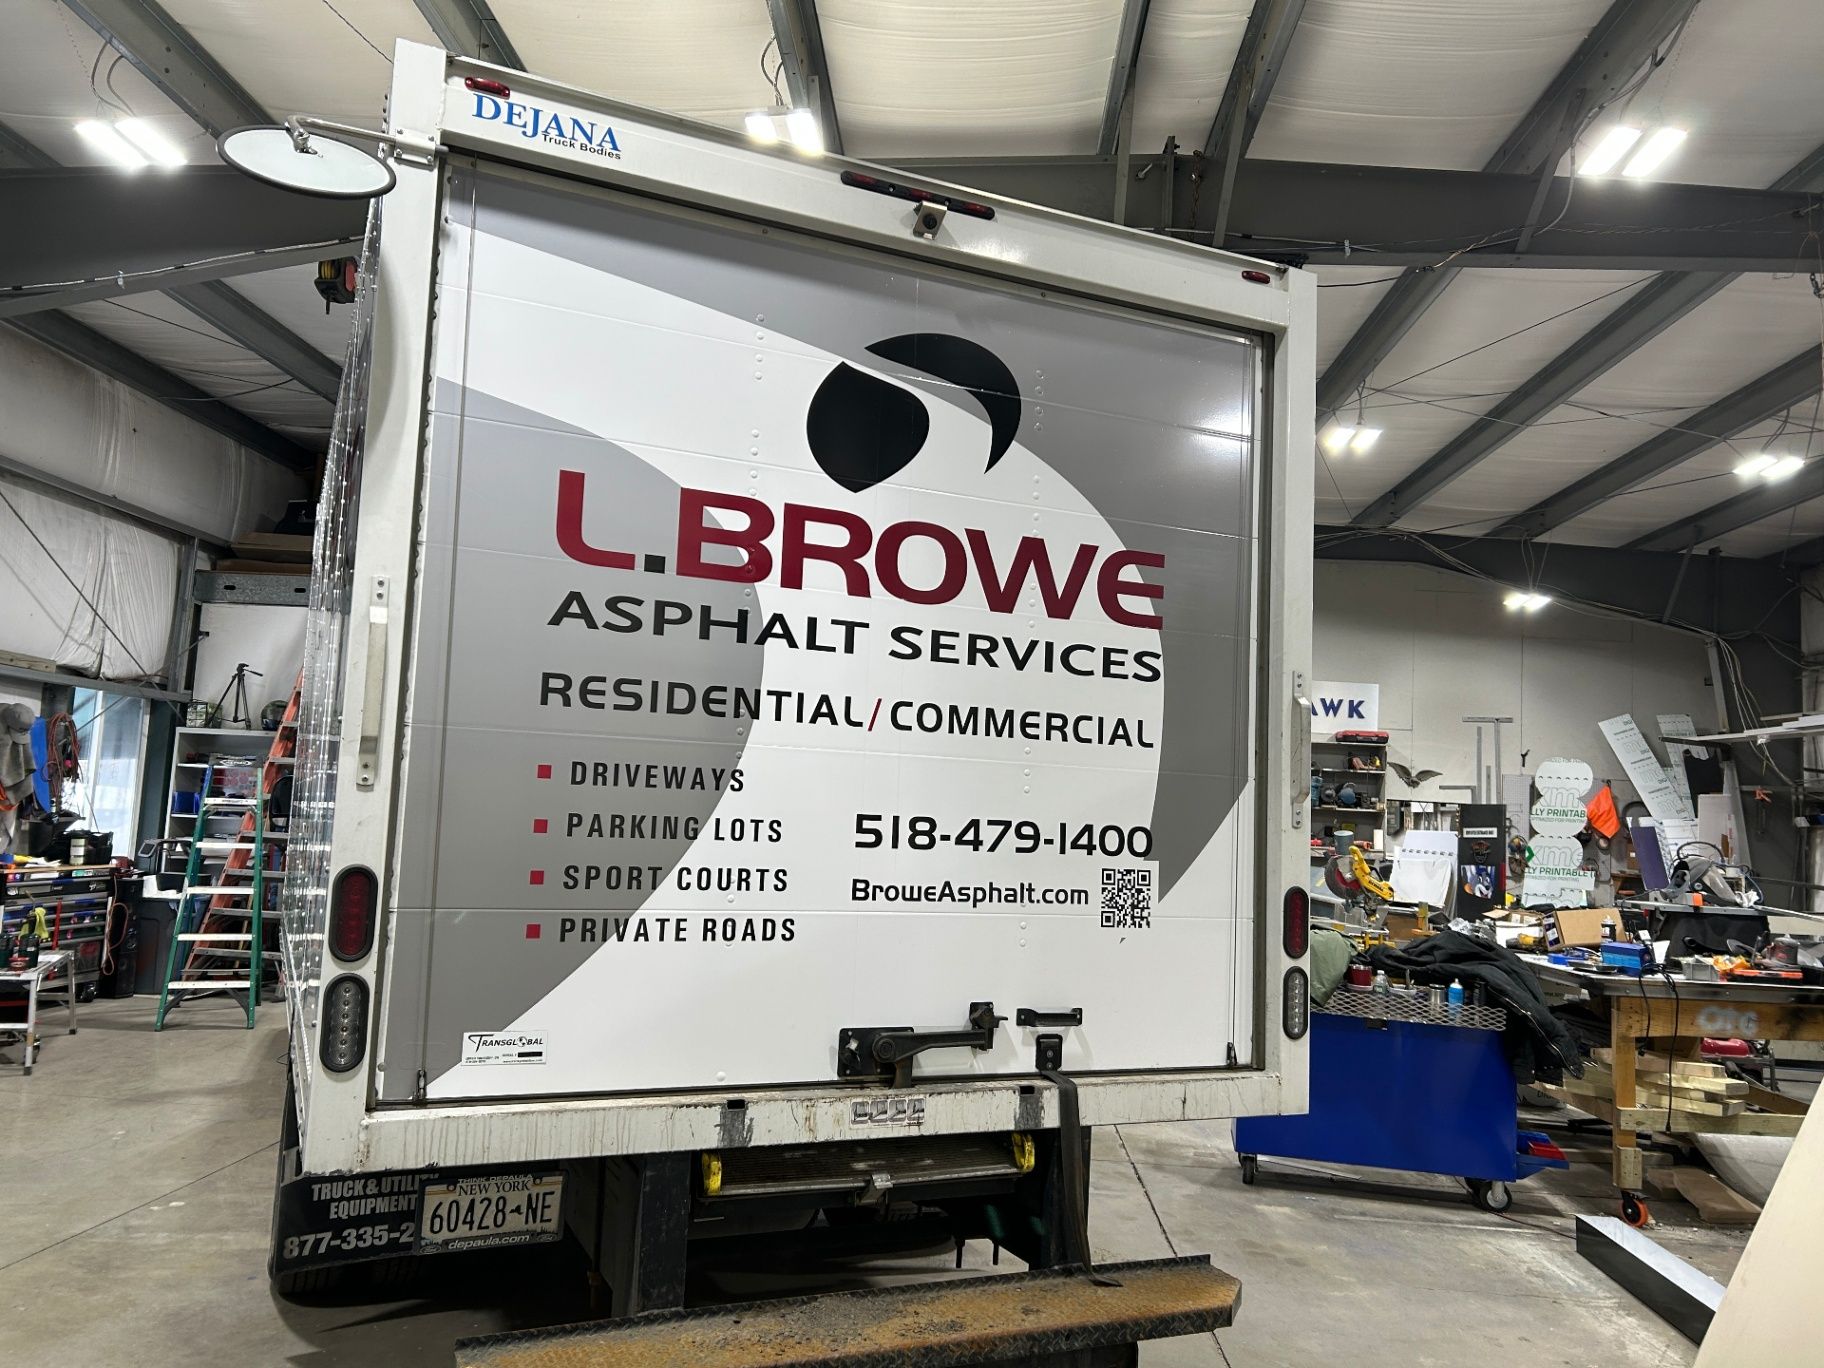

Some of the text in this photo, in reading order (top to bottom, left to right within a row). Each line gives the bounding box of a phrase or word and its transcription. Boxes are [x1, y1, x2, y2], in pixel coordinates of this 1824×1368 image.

[472, 93, 621, 152] DEJANA
[542, 134, 621, 160] Truck Bodies
[556, 469, 1165, 630] L.BROWE
[547, 591, 1162, 682] ASPHALT SERVICES
[540, 672, 1154, 748] RESIDENTIAL/COMMERCIAL
[1312, 697, 1365, 719] WK
[570, 761, 745, 792] DRIVEWAYS
[566, 812, 782, 843] PARKING LOTS
[854, 813, 1153, 858] 518-479-1400
[562, 865, 788, 892] SPORT COURTS
[851, 878, 1089, 908] BroweAsphalt.com
[560, 917, 795, 942] PRIVATE ROADS
[458, 1180, 530, 1196] NEW YORK
[489, 1174, 533, 1182] DEPAULA
[329, 1194, 417, 1219] EQUIPMENT
[430, 1191, 555, 1234] 60428 NE
[448, 1234, 529, 1250] depaula.com
